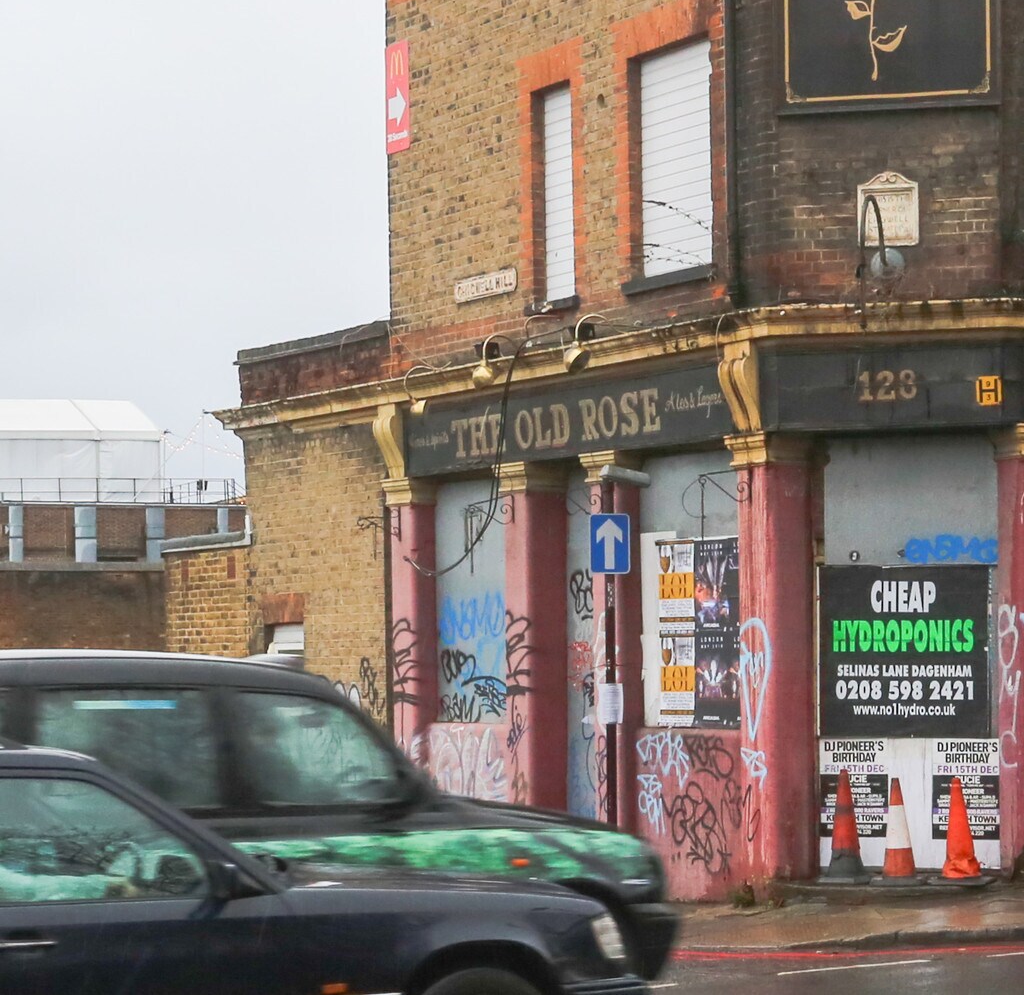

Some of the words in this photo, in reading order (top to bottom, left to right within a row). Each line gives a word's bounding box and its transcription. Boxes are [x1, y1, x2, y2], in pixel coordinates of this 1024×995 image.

[858, 369, 918, 401] 128
[451, 412, 508, 458] THE
[515, 404, 571, 450] OLD
[579, 388, 662, 442] ROSE
[660, 574, 693, 599] LOL
[871, 580, 937, 613] CHEAP
[832, 619, 974, 652] HYDROPONICS
[837, 665, 880, 678] SELINAS
[882, 665, 909, 678] LANE
[912, 665, 972, 678] DAGENHAM
[662, 667, 694, 692] LOL
[836, 680, 882, 700] 0208
[889, 681, 923, 700] 598
[929, 681, 974, 700] 2421
[853, 703, 956, 718] www.no1hydro.co.uk
[824, 741, 838, 755] DJ
[839, 740, 884, 755] PIONEER'S
[937, 742, 951, 756] DJ
[951, 742, 998, 756] PIONEER'S
[832, 752, 876, 764] BIRTHDAY
[945, 753, 990, 764] BIRTHDAY
[824, 765, 840, 773] FRI
[867, 764, 885, 773] DEC
[937, 765, 953, 774] FRI
[955, 765, 976, 774] 15TH
[980, 765, 998, 774] DEC
[974, 815, 997, 824] TOWN
